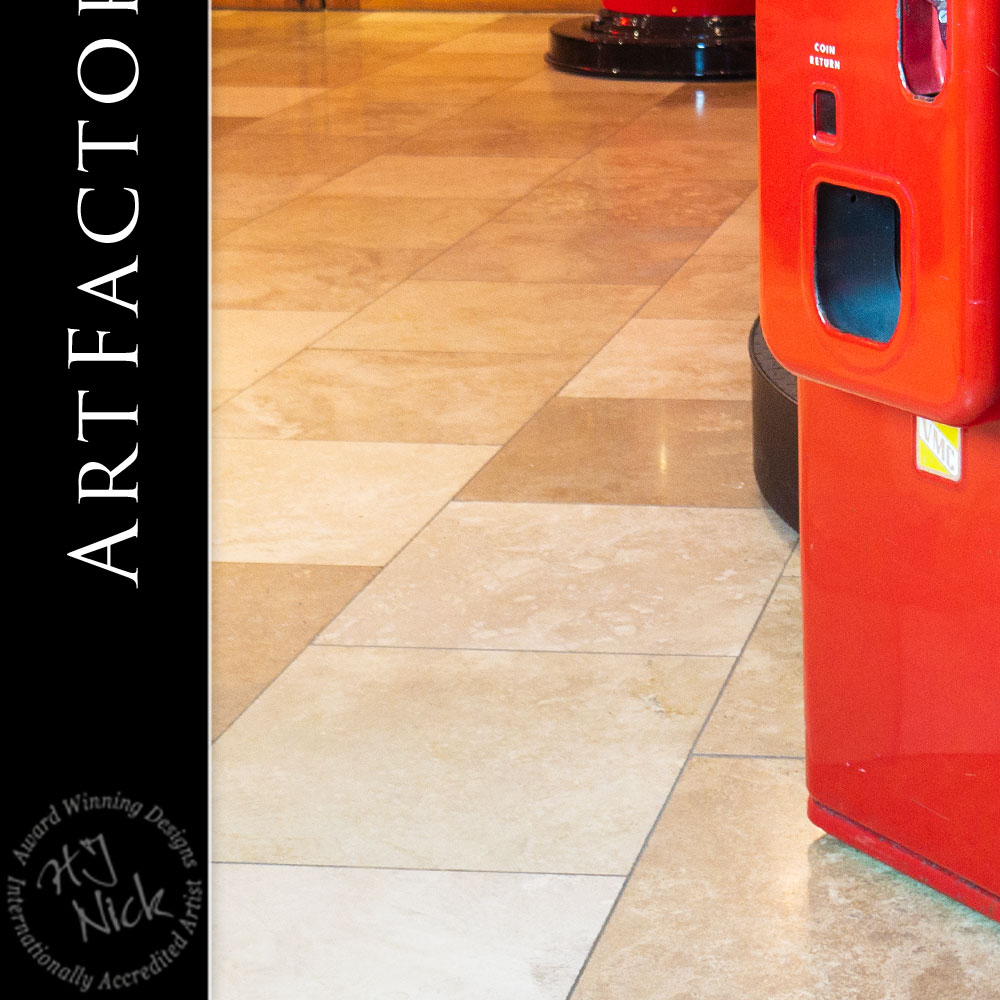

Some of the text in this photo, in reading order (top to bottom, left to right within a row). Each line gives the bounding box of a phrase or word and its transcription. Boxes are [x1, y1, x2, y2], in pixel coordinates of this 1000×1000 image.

[814, 42, 836, 55] COIN
[809, 55, 841, 70] RETURN
[922, 419, 955, 472] VMC
